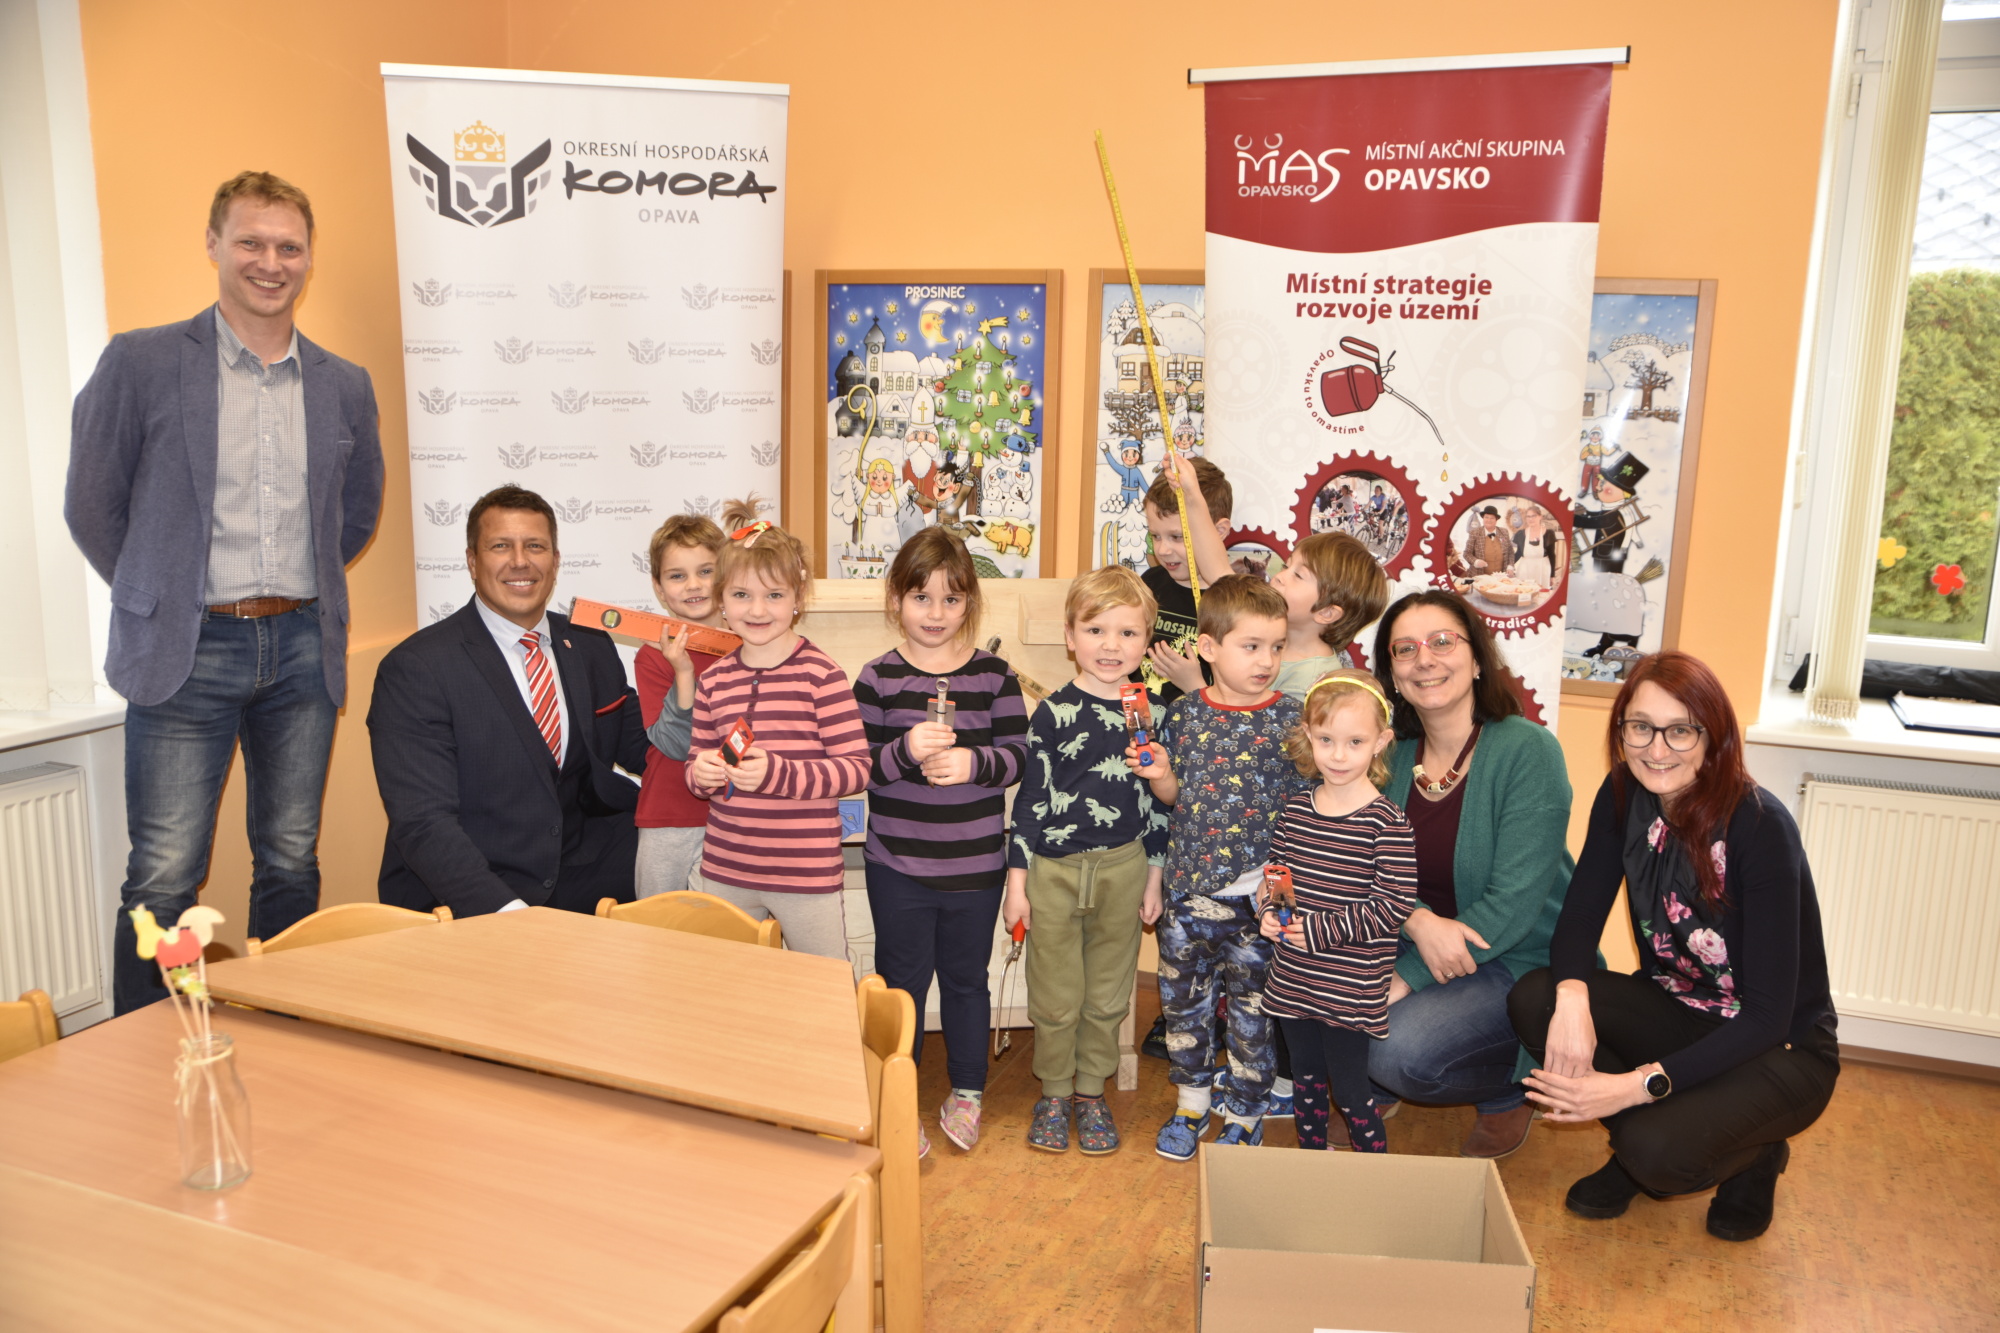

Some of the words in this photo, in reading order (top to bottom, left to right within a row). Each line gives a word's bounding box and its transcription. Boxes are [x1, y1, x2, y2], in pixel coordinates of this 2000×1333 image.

[563, 140, 637, 158] OKRESNÍ
[645, 142, 769, 163] HOSPODÁŘSKÁ
[1365, 141, 1425, 160] MÍSTNÍ
[1428, 138, 1483, 159] AKČNÍ
[1486, 139, 1566, 158] SKUPINA
[562, 160, 777, 204] KOMORA
[1364, 166, 1490, 191] OPAVSKO
[1238, 184, 1317, 198] OPAVSKO
[638, 208, 700, 224] OPAVA
[905, 286, 965, 299] PROSINEC
[1286, 272, 1367, 295] Místní
[1373, 272, 1493, 302] strategie
[1295, 297, 1392, 324] rozvoje
[1399, 297, 1479, 320] území
[1485, 616, 1536, 629] tradice
